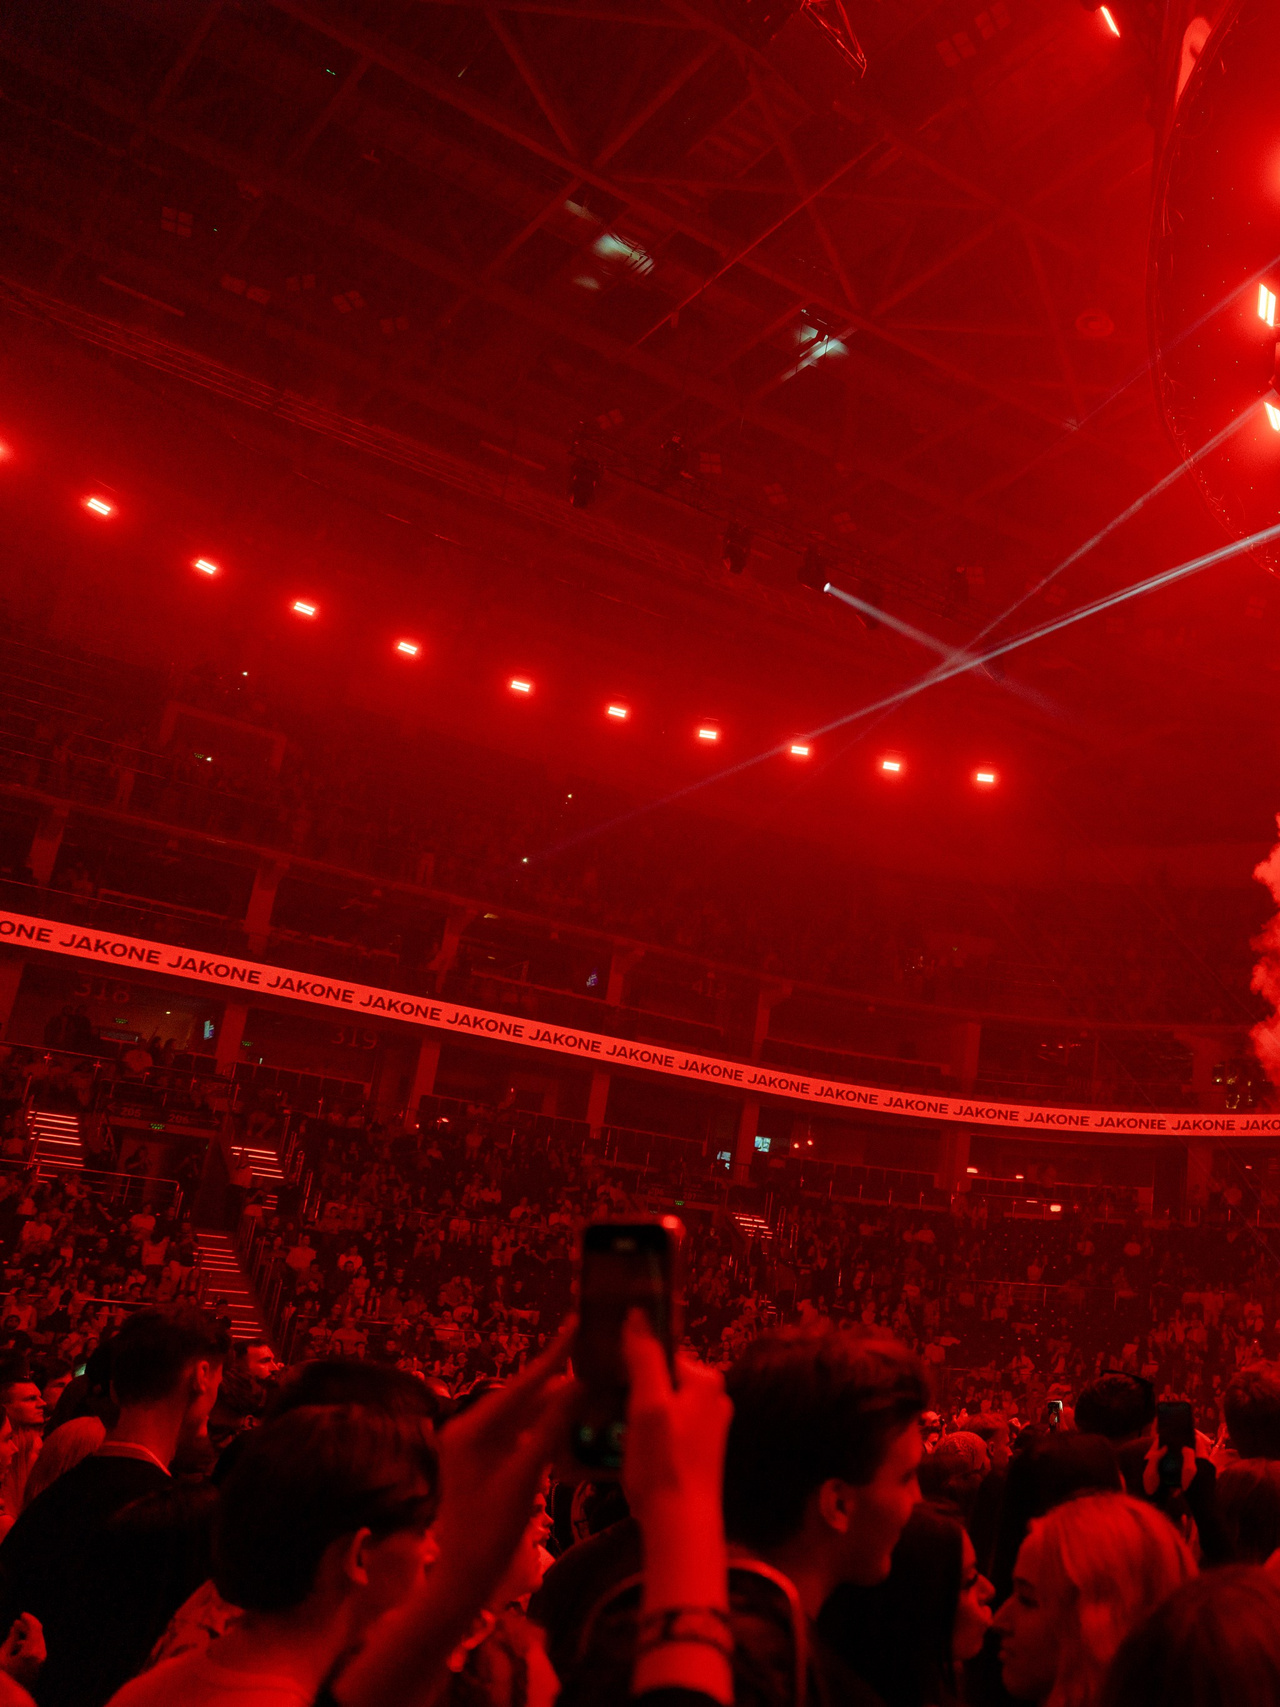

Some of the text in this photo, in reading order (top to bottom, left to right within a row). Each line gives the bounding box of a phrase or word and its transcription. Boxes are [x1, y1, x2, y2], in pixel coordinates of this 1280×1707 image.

[59, 934, 161, 965] JAKONE
[167, 955, 262, 985] JAKONE
[266, 975, 355, 1004] JAKONE
[359, 994, 442, 1021] JAKONE
[446, 1012, 525, 1038] JAKONE
[528, 1029, 602, 1053] JAKONE
[605, 1044, 675, 1068] JAKONE
[678, 1059, 744, 1082] JAKONE
[747, 1073, 810, 1094] JAKONE
[814, 1086, 879, 1105] JAKONE
[883, 1097, 949, 1114] JAKONE
[953, 1105, 1019, 1121] JAKONE
[1024, 1112, 1090, 1126] JAKONE
[1171, 1119, 1236, 1131] JAKONE
[331, 1026, 378, 1050] 319
